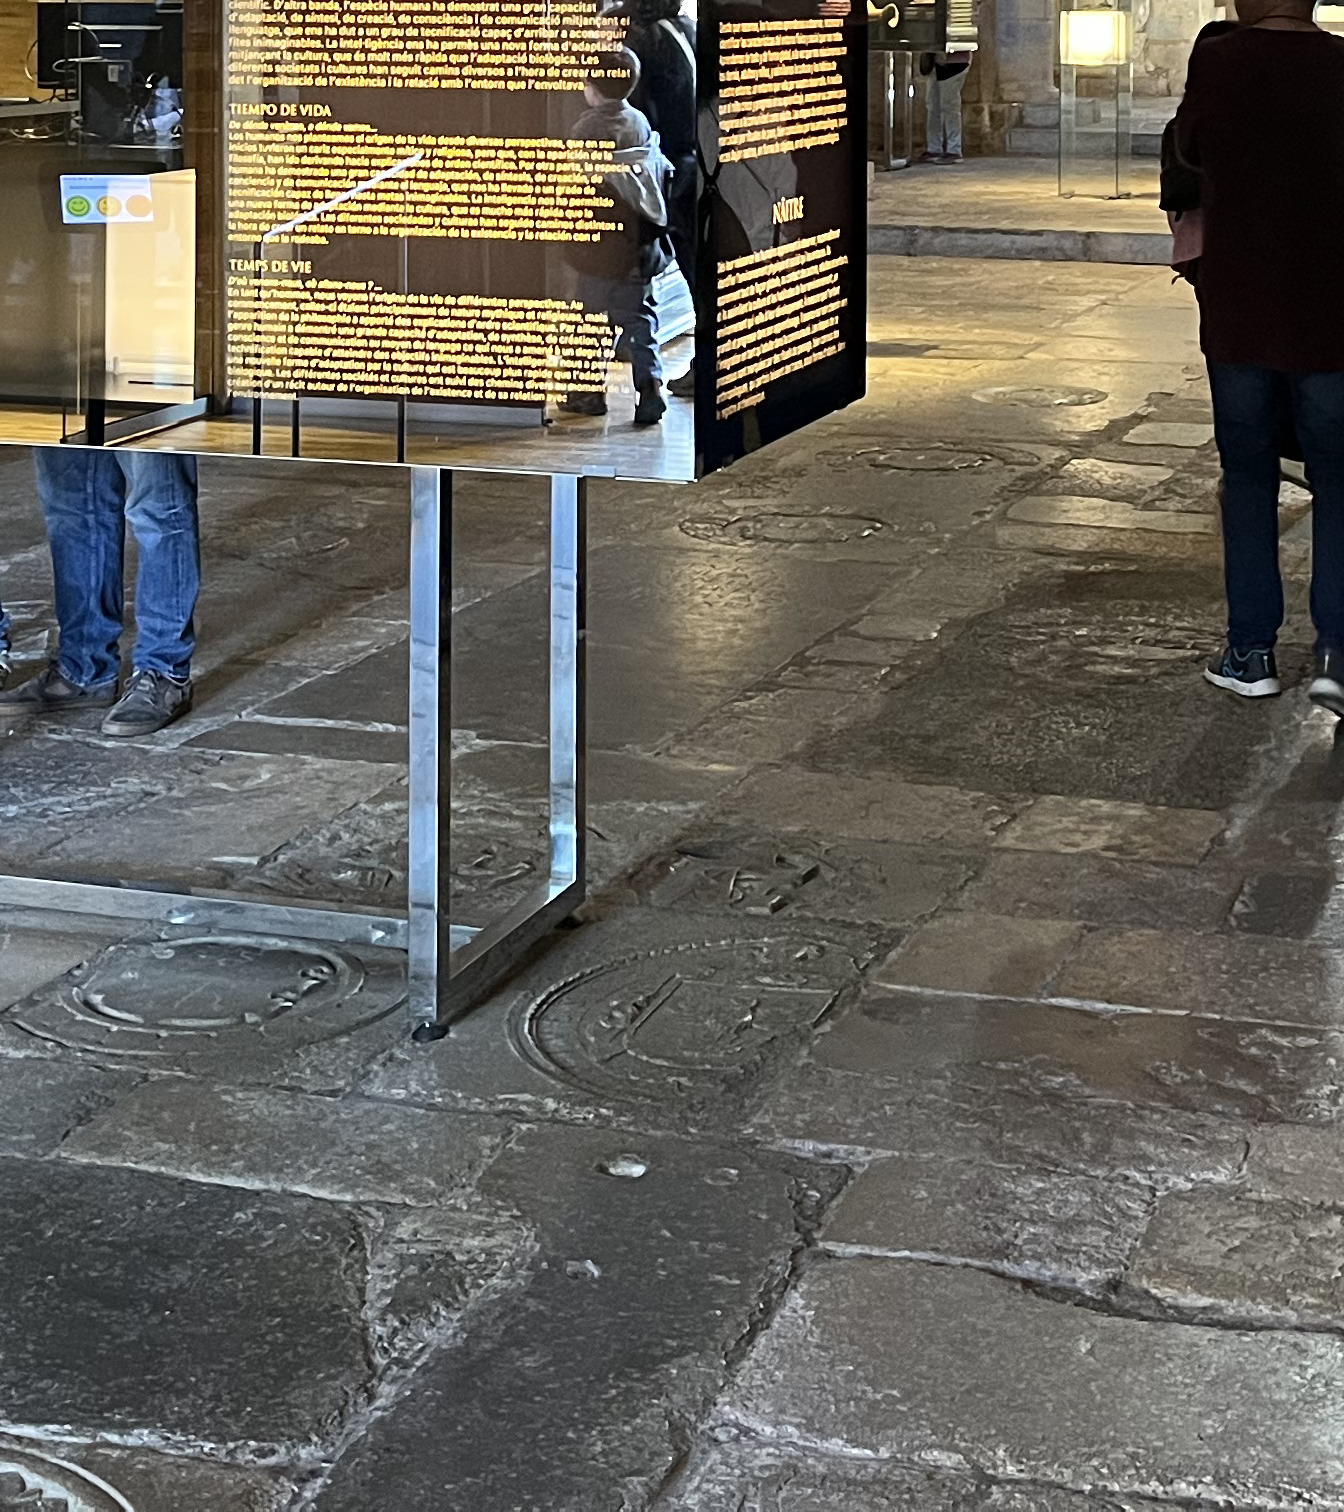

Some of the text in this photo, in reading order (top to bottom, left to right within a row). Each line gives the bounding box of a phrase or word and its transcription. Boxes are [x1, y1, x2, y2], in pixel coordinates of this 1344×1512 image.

[229, 103, 332, 117] TIEMPO DE VIDA
[229, 258, 312, 274] TEMPS DE VIE
